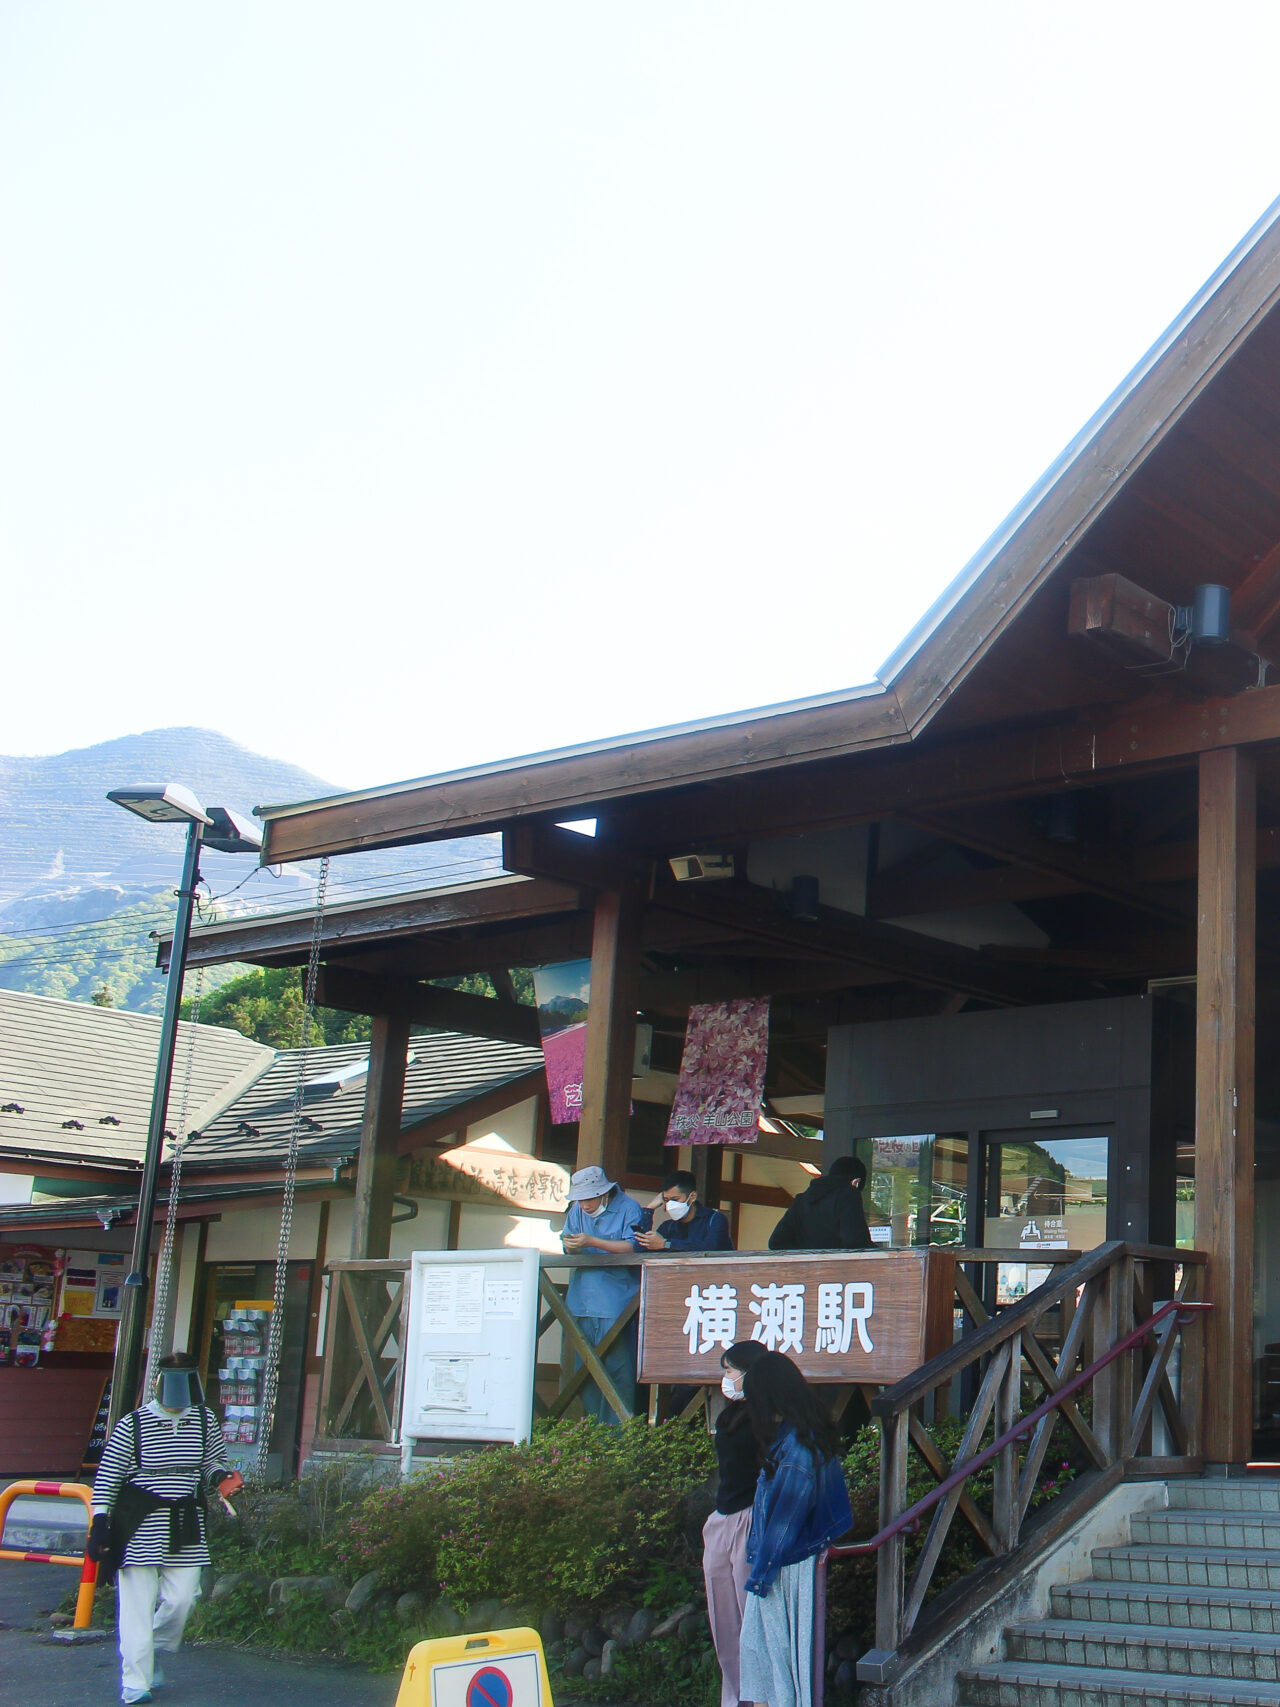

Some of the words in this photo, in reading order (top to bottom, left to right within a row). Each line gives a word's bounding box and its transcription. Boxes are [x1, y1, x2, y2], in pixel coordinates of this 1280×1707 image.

[676, 1115, 698, 1129] 秩父
[703, 1111, 754, 1127] 羊山公園
[682, 1281, 875, 1355] 横瀬駅
